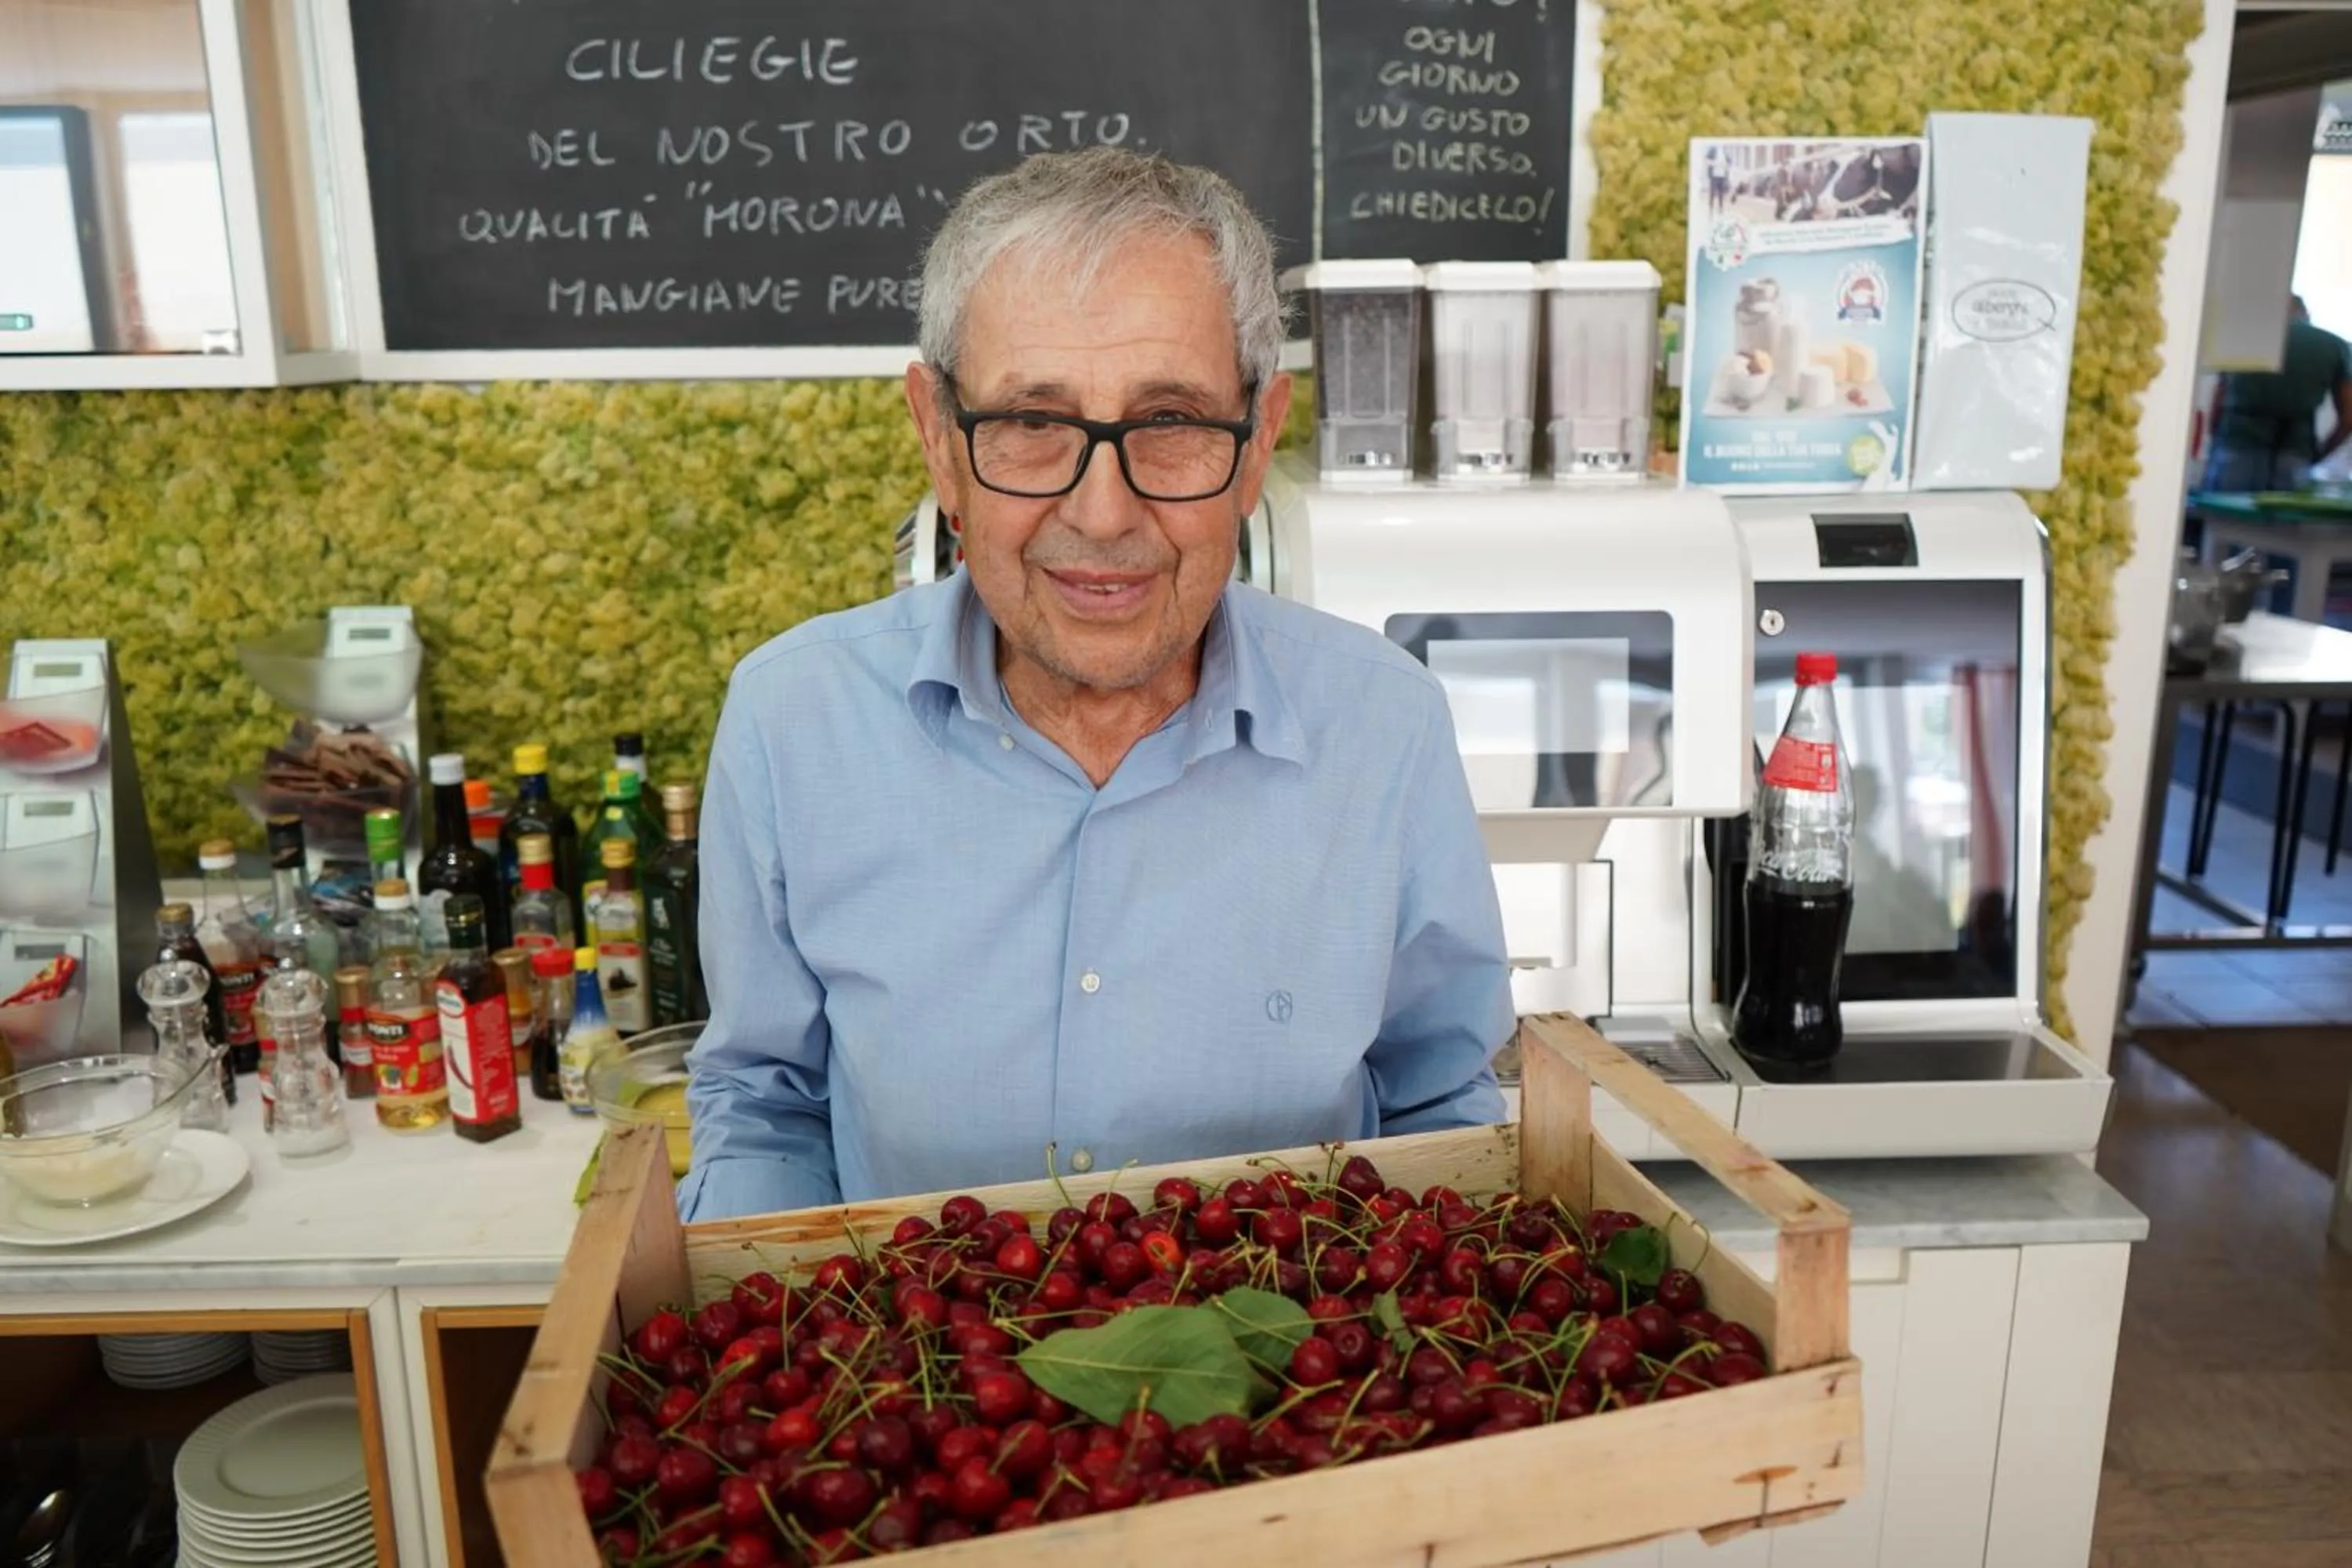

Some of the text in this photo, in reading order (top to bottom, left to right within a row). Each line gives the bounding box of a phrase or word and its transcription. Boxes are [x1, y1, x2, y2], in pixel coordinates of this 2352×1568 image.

[564, 36, 860, 85] CILIEGIE
[1404, 25, 1496, 64] OGNI
[1377, 60, 1521, 96] GIORNO
[1354, 104, 1532, 138] UN GUSTO
[528, 128, 615, 170] DEL
[657, 119, 913, 167] NOSTRO
[548, 274, 920, 318] MANGIANE PURE
